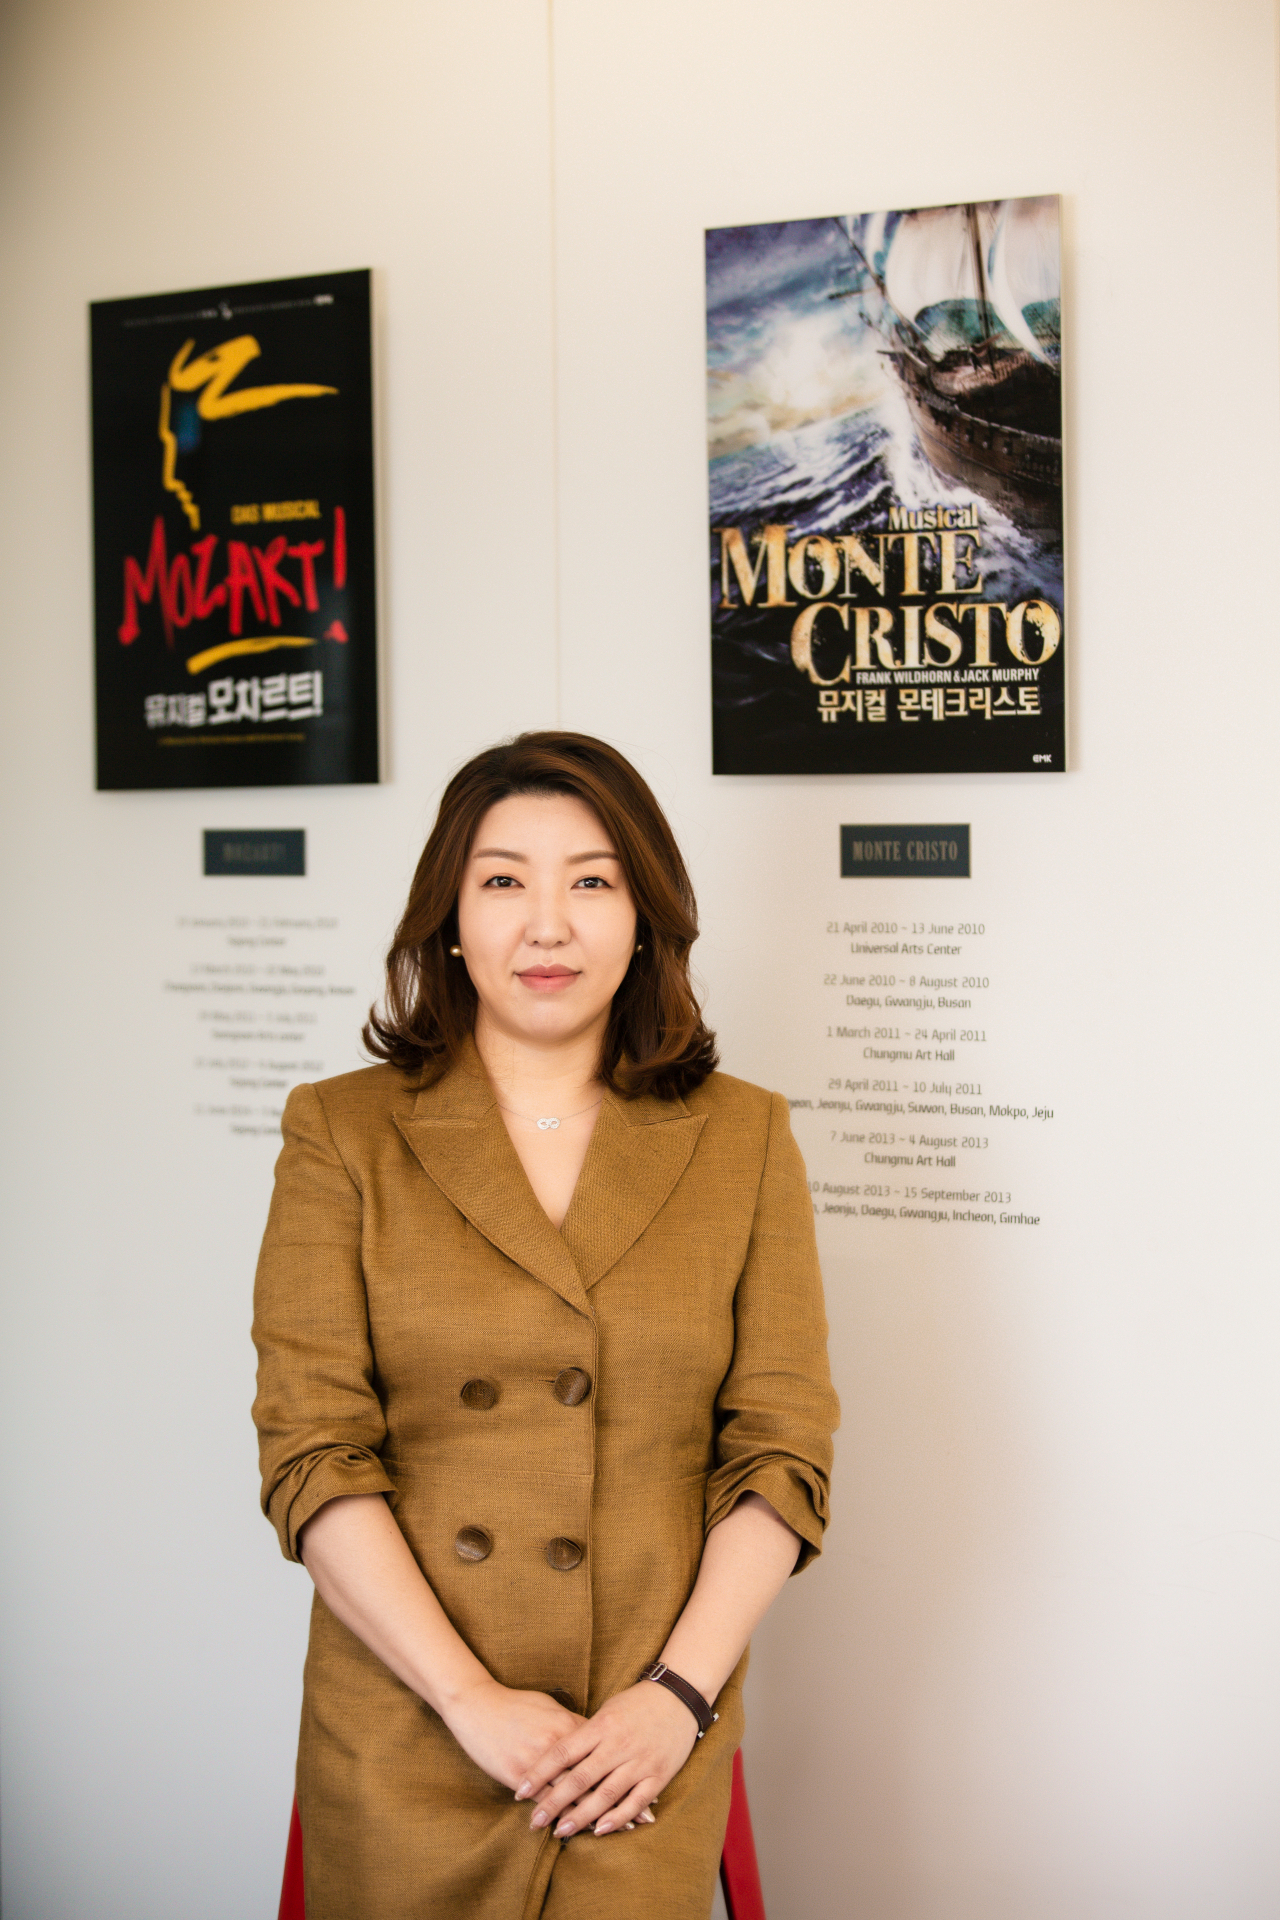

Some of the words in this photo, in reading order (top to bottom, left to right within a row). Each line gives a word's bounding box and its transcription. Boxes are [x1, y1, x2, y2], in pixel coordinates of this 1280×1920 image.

[889, 502, 979, 531] Musical
[712, 523, 983, 609] MONTE
[790, 598, 1062, 686] CRISTO
[856, 671, 892, 685] FRANK
[893, 670, 951, 684] WILDHORN
[992, 667, 1040, 682] MURPHY
[817, 689, 888, 722] 뮤지컬
[897, 686, 1042, 722] 몬테크리스토
[852, 840, 902, 862] MONTE
[906, 840, 959, 861] CRISTO
[826, 921, 840, 934] 21
[842, 921, 868, 936] April
[870, 921, 899, 935] 2010
[911, 922, 926, 935] 13
[927, 923, 955, 935] June
[957, 922, 986, 936] 2010
[850, 942, 899, 955] Universal
[900, 942, 925, 955] Arts
[926, 943, 962, 956] Center
[823, 973, 838, 987] 22
[839, 974, 866, 987] June
[867, 974, 896, 987] 2010
[918, 975, 958, 991] August
[961, 976, 990, 989] 2010
[937, 996, 972, 1009] Busan
[835, 1026, 871, 1039] March
[873, 1026, 901, 1040] 2011
[914, 1028, 929, 1041] 24
[931, 1028, 957, 1044] April
[959, 1029, 987, 1043] 2011
[862, 1046, 913, 1063] Chungmu
[914, 1048, 932, 1061] Art
[934, 1049, 956, 1062] Hall
[844, 1078, 870, 1093] April
[871, 1079, 899, 1093] 2011
[912, 1081, 927, 1094] 10
[929, 1081, 953, 1097] July
[954, 1082, 983, 1096] 2011
[1031, 1106, 1055, 1121] Jeju
[840, 1131, 866, 1144] June
[867, 1132, 896, 1145] 2013
[918, 1134, 958, 1151] August
[960, 1136, 989, 1149] 2013
[863, 1151, 914, 1168] Chungmu
[915, 1154, 933, 1167] Art
[935, 1155, 956, 1168] Hall
[821, 1182, 861, 1198] August
[863, 1184, 891, 1197] 2013
[904, 1186, 918, 1199] 15
[920, 1187, 980, 1203] September
[983, 1190, 1012, 1204] 2013
